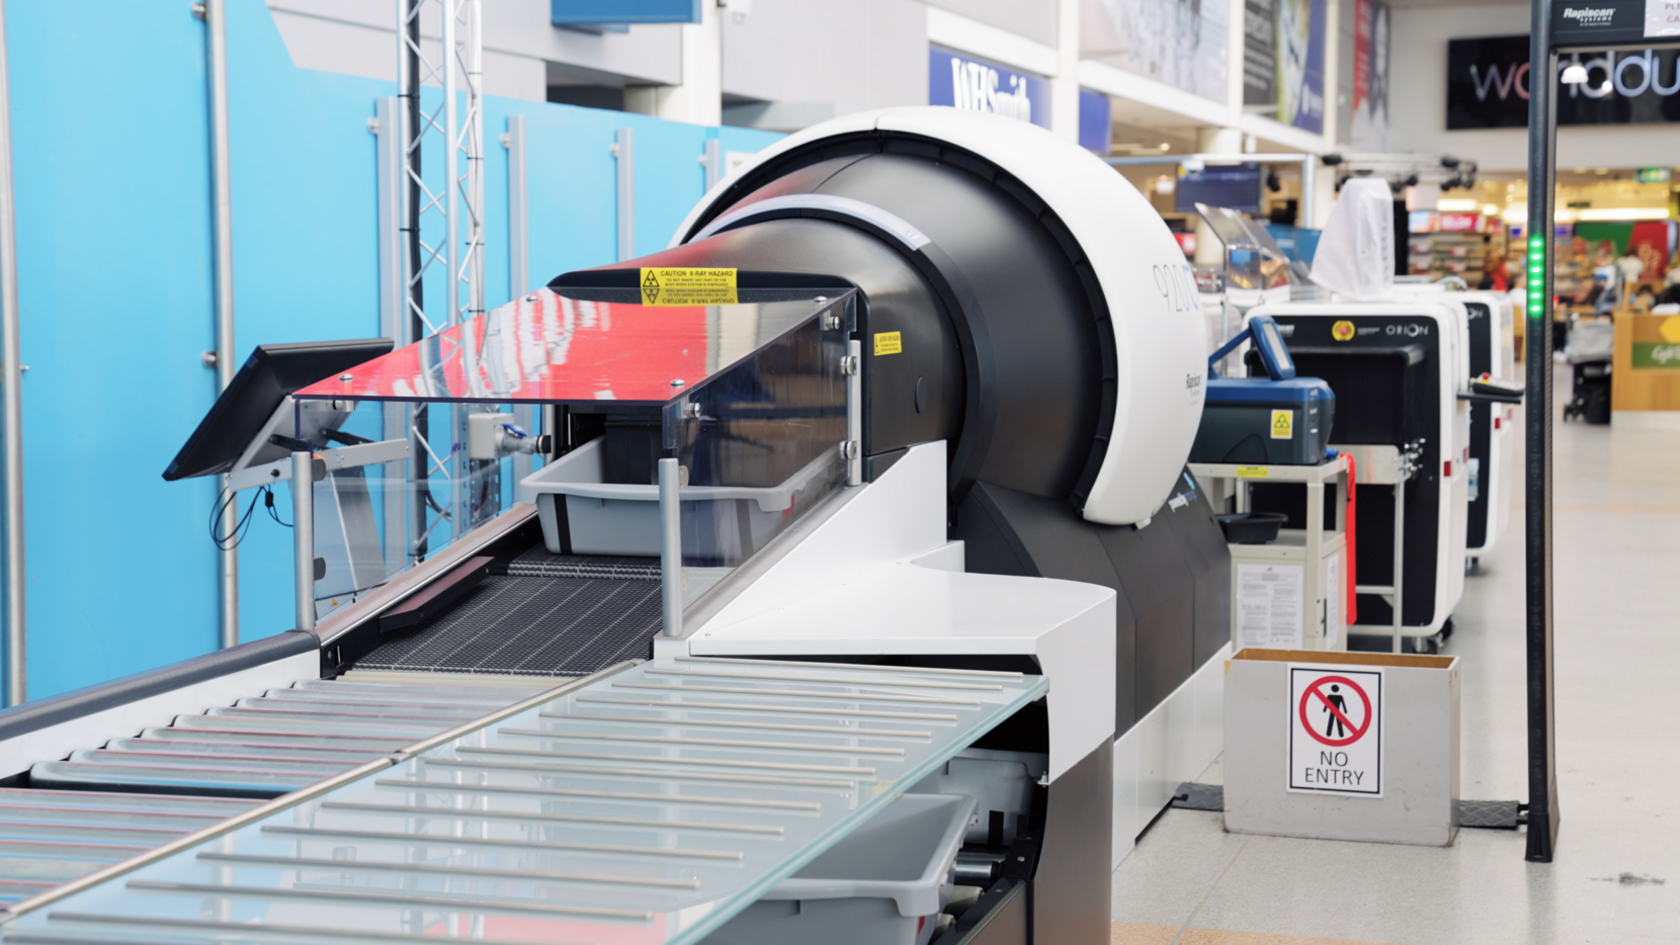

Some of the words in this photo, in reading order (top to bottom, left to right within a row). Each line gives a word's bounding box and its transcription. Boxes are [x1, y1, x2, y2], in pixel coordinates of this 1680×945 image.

[1563, 7, 1615, 19] Rapiscan
[1386, 324, 1428, 337] ORION
[1320, 751, 1348, 767] NO
[1305, 767, 1364, 785] ENTRY
